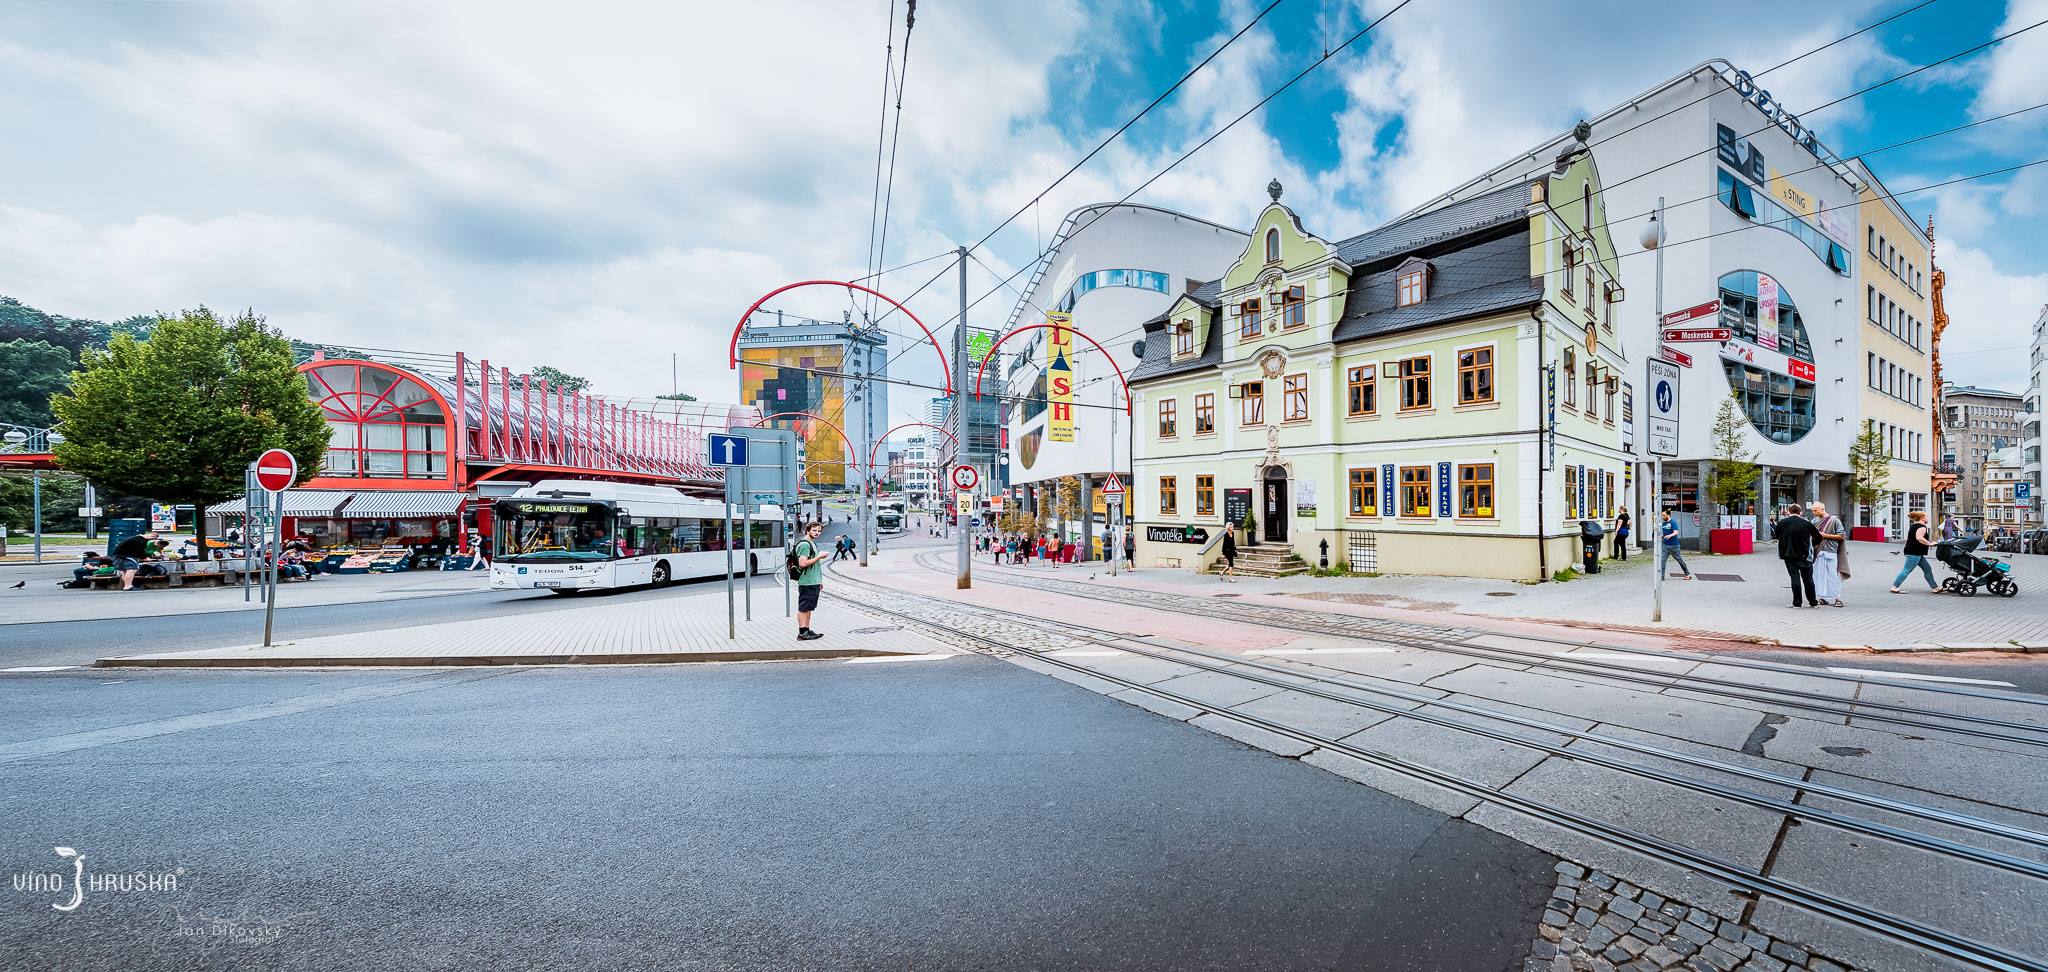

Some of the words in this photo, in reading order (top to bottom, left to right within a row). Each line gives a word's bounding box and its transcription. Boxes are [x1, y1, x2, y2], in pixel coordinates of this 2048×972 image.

[1788, 188, 1806, 209] STING
[1681, 331, 1714, 339] Moskevská
[1651, 364, 1663, 375] PĚŠÍ
[1664, 368, 1677, 379] ZÓNA
[2017, 484, 2027, 494] P
[519, 503, 533, 513] 12
[535, 505, 568, 513] PAVLOVICE
[960, 500, 970, 509] 20
[1148, 527, 1183, 542] Vinotéka
